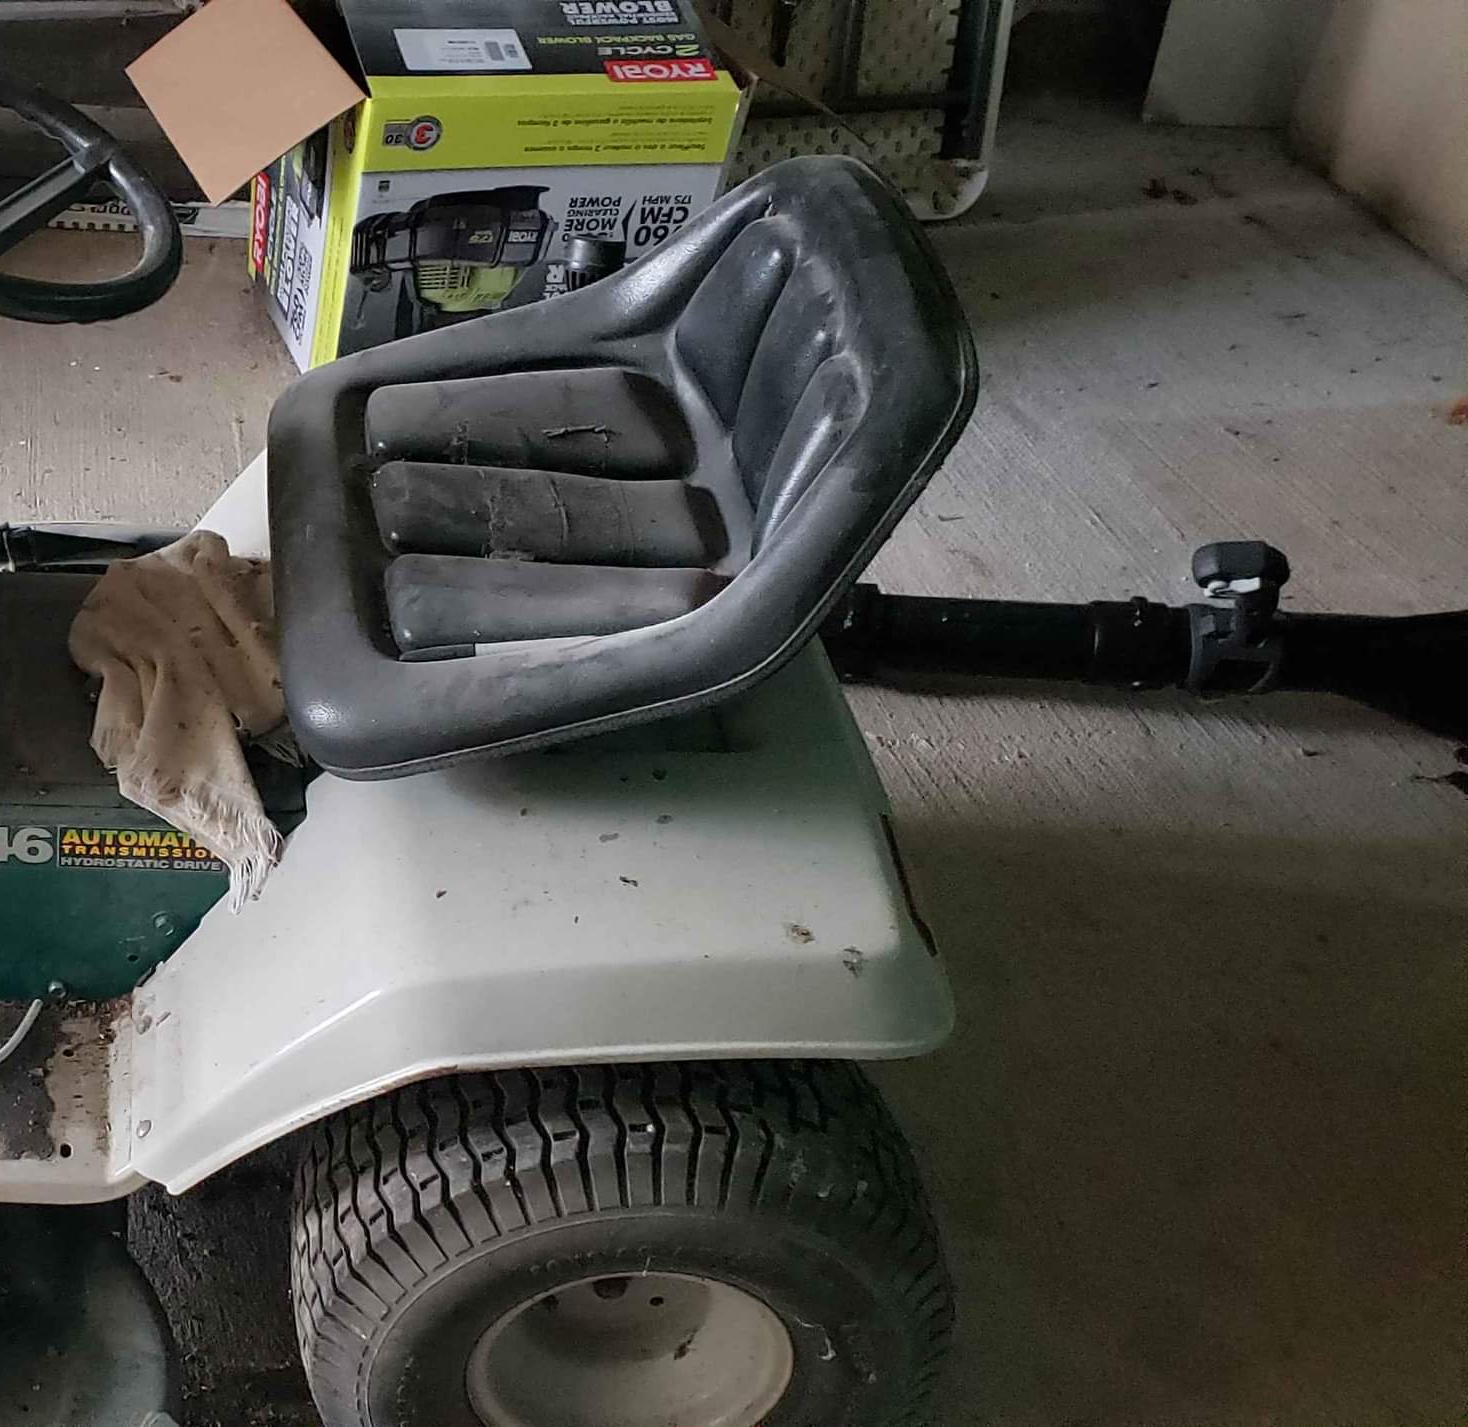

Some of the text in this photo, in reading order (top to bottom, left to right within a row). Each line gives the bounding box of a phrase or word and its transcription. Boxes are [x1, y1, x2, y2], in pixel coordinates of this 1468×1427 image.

[560, 1, 674, 14] BLOWER
[537, 35, 593, 44] BLOWER
[668, 33, 695, 42] GAS
[597, 44, 700, 56] 2 CYCLE
[613, 63, 712, 80] RYOBI
[415, 125, 434, 145] 3
[569, 195, 622, 207] POWER
[642, 194, 692, 205] 175 MPH
[252, 173, 268, 264] RYOBI
[567, 209, 620, 217] CLEARING
[640, 206, 690, 225] CFM
[564, 218, 618, 232] MORE
[508, 231, 539, 242] RYOBI
[634, 225, 682, 247] 60
[61, 828, 194, 848] AUTOMAT
[62, 845, 217, 859] TRANSMISSIO
[60, 855, 222, 871] HYDROSTATIC DRIVE
